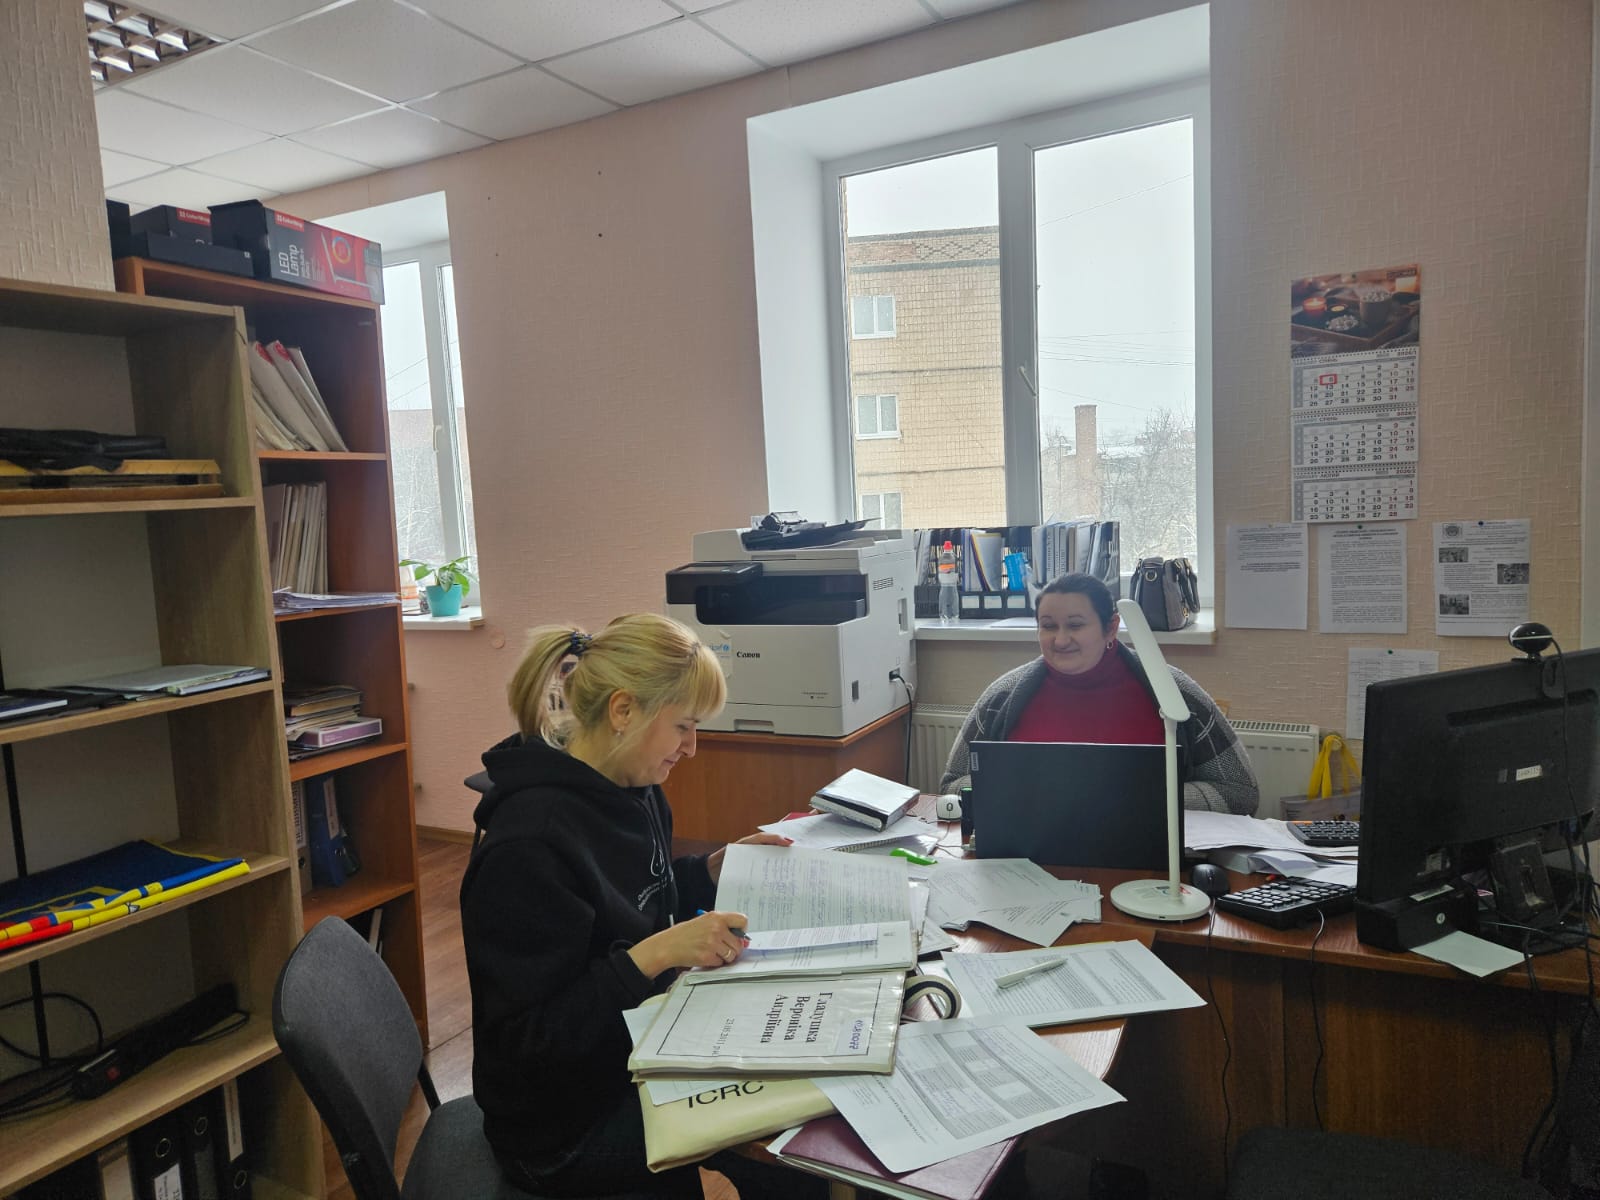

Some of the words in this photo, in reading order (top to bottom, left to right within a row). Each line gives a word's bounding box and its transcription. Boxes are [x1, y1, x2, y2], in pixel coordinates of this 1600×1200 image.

[278, 252, 290, 275] LED
[289, 244, 300, 277] Lamp
[760, 994, 789, 1044] Андріївна
[784, 995, 810, 1041] Вероніка
[806, 991, 833, 1043] Гладушка
[688, 1080, 764, 1109] ICRC
